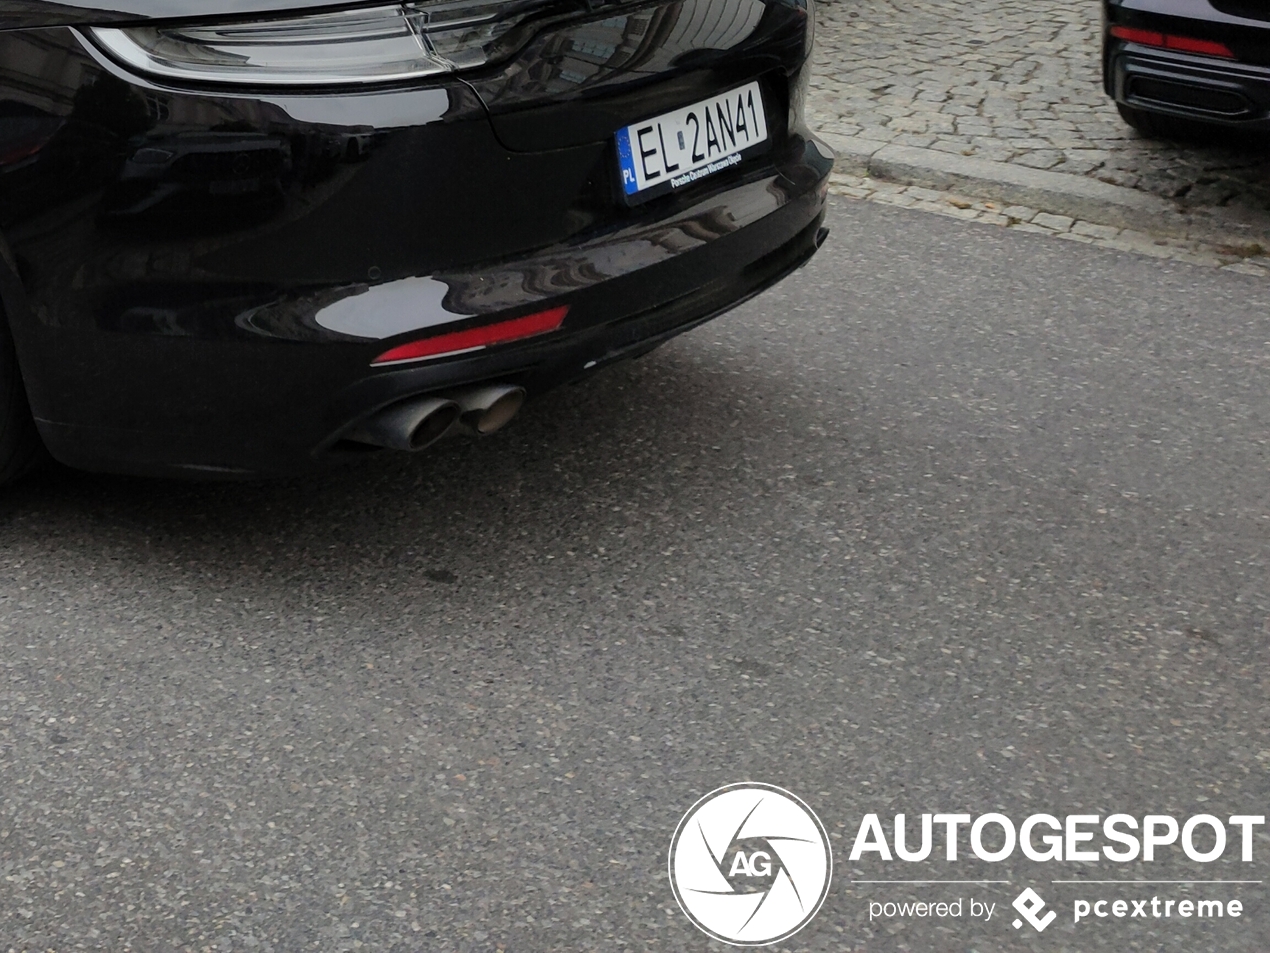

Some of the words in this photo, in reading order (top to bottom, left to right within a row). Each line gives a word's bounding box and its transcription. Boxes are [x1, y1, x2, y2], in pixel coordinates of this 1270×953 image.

[637, 122, 680, 181] EL
[685, 90, 759, 164] 2AN41
[623, 169, 635, 185] PL
[671, 174, 690, 188] Porsche
